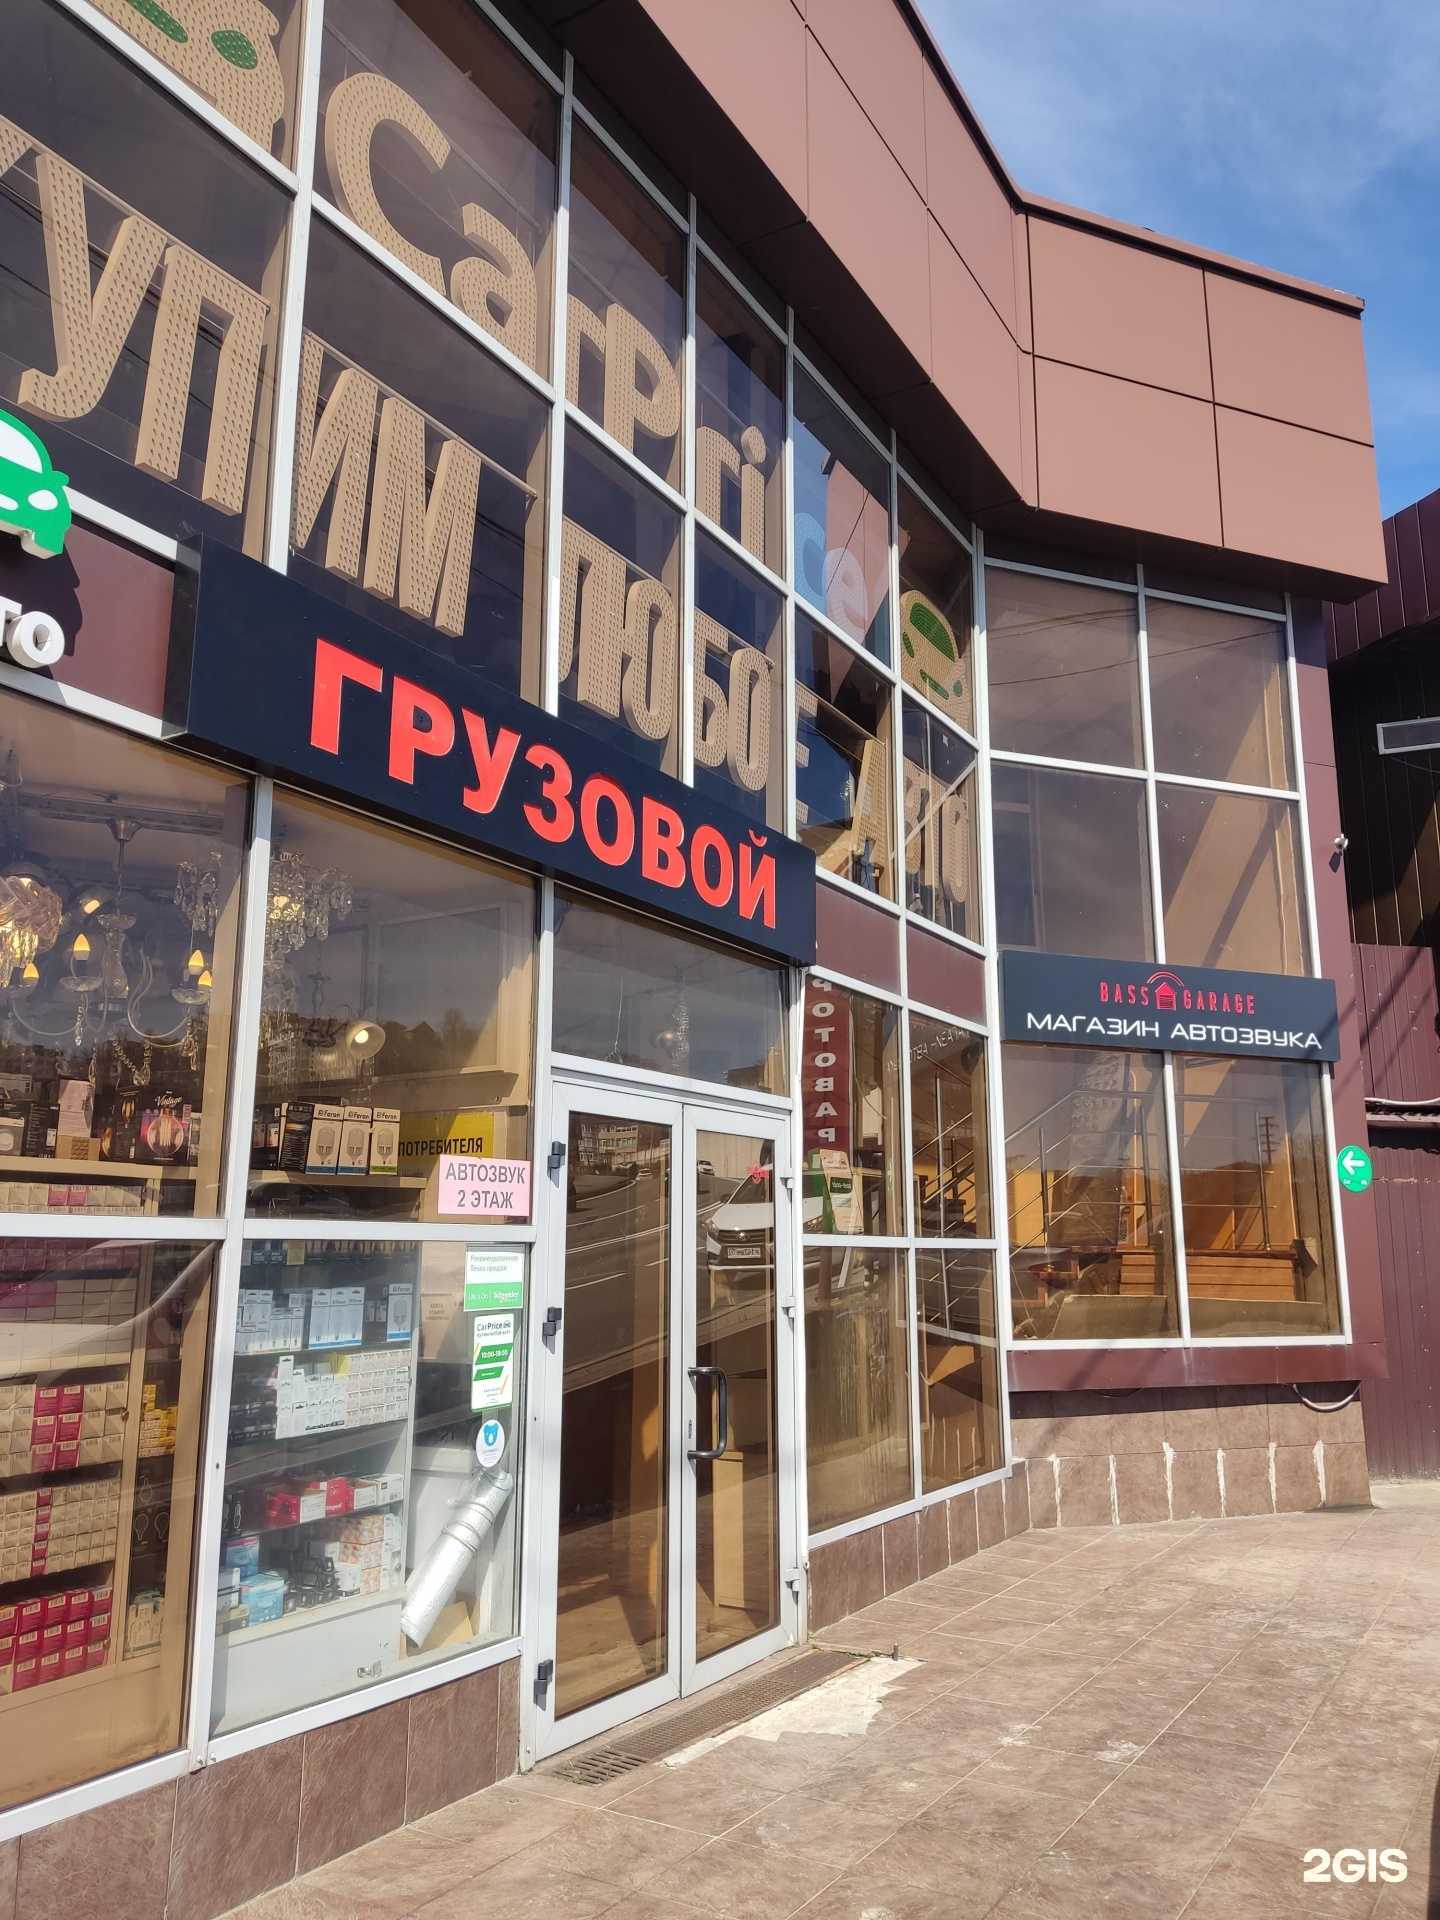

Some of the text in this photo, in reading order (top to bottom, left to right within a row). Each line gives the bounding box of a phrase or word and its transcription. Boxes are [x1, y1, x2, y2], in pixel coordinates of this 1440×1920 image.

[0, 112, 482, 638] УПИМ
[310, 637, 776, 929] ГРУЗОВОЙ
[1100, 981, 1255, 1015] BASS GARAGE
[1027, 1012, 1322, 1050] МАГАЗИН АВТОЗВУКА
[399, 1137, 483, 1157] ПОТРЕБИТЕЛЯ
[445, 1161, 526, 1184] АВТОЗВУК
[457, 1190, 514, 1209] 2 ЭТАЖ
